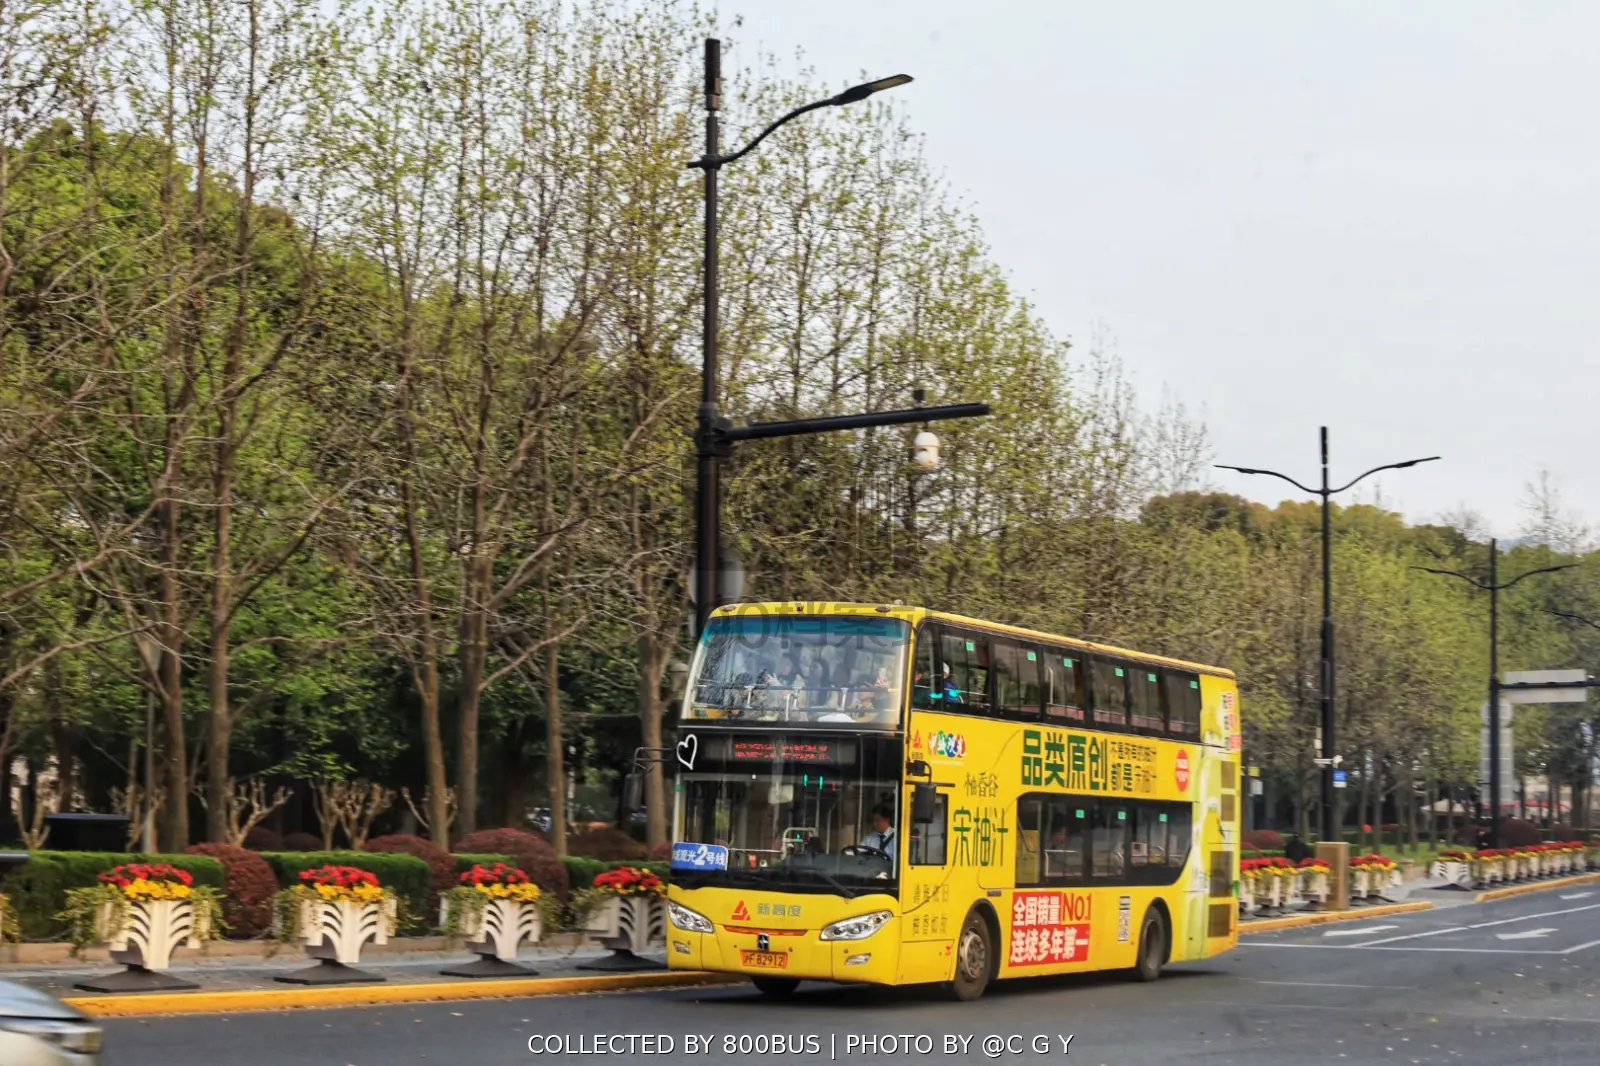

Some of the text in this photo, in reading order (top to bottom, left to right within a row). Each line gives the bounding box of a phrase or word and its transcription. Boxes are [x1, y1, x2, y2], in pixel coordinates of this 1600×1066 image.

[1022, 729, 1108, 791] 品类原创
[952, 806, 1009, 867] 宋柚汁
[1013, 896, 1060, 926] 全国销量
[1010, 926, 1089, 963] 连续多年第一
